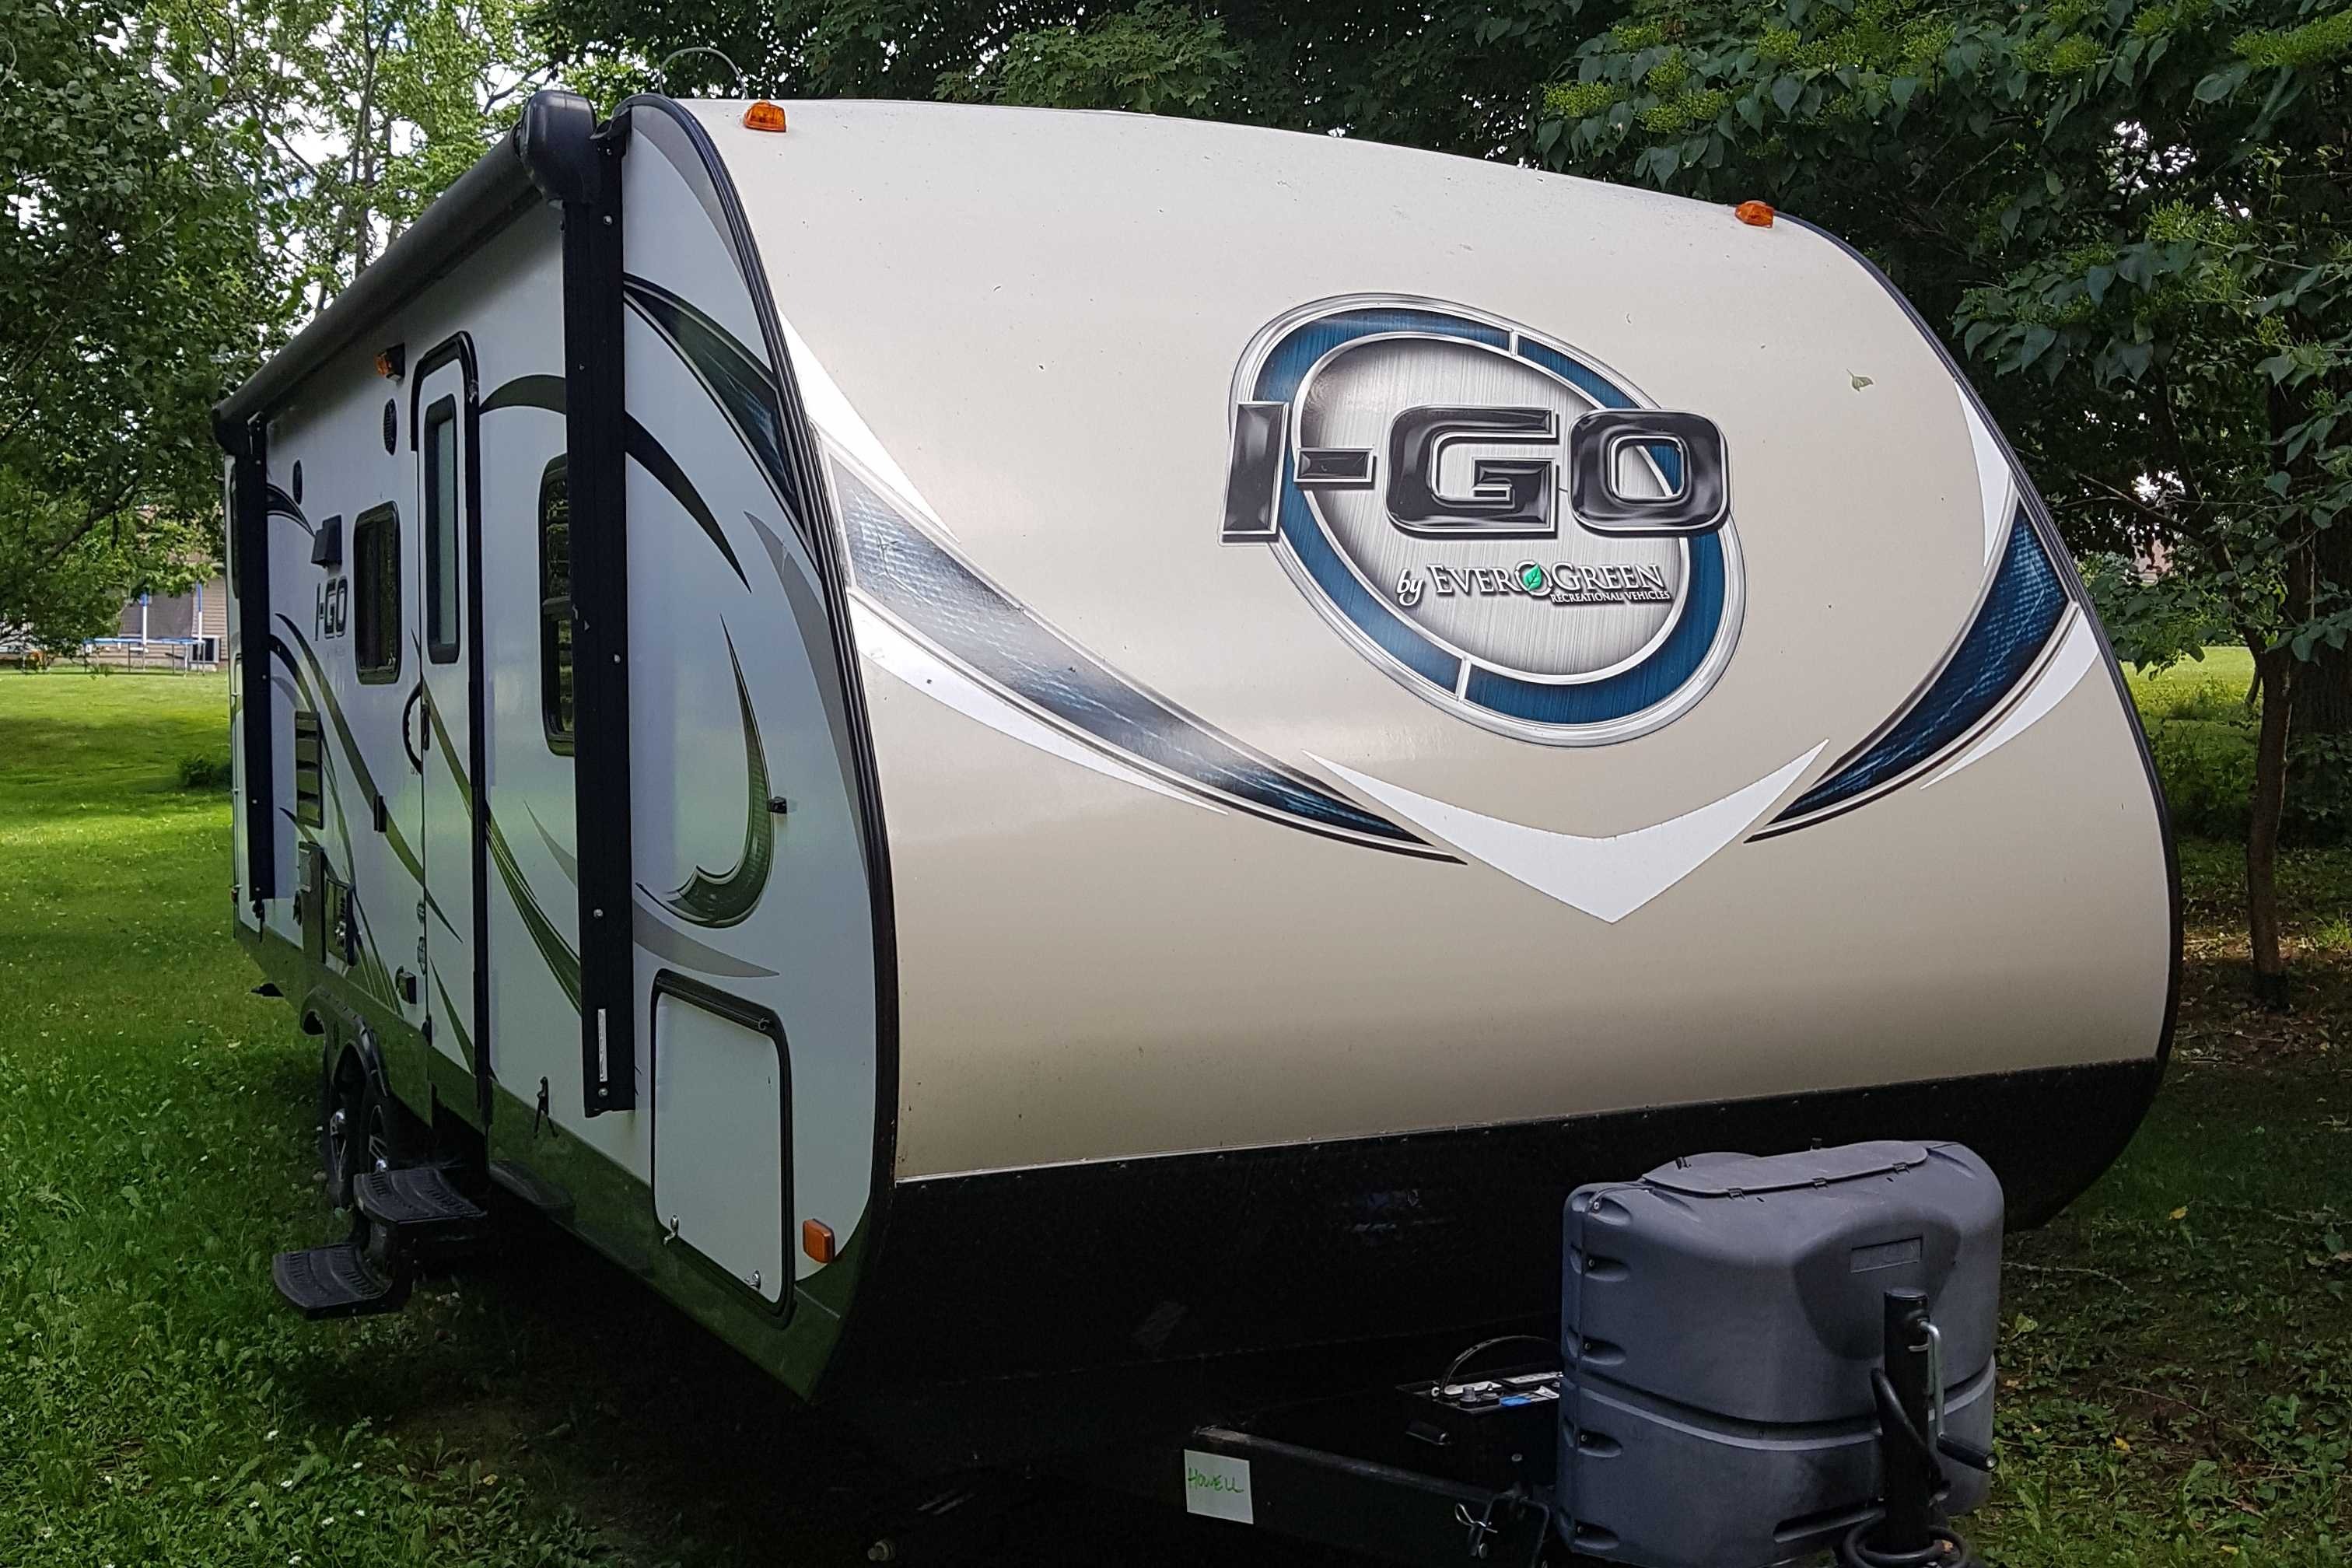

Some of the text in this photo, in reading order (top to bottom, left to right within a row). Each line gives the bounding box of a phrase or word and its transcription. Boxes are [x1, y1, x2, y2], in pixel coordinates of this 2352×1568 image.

[1218, 400, 1730, 542] I-GO
[1395, 568, 1423, 606] by
[1550, 590, 1671, 604] RECREATIONAL VEHICLES
